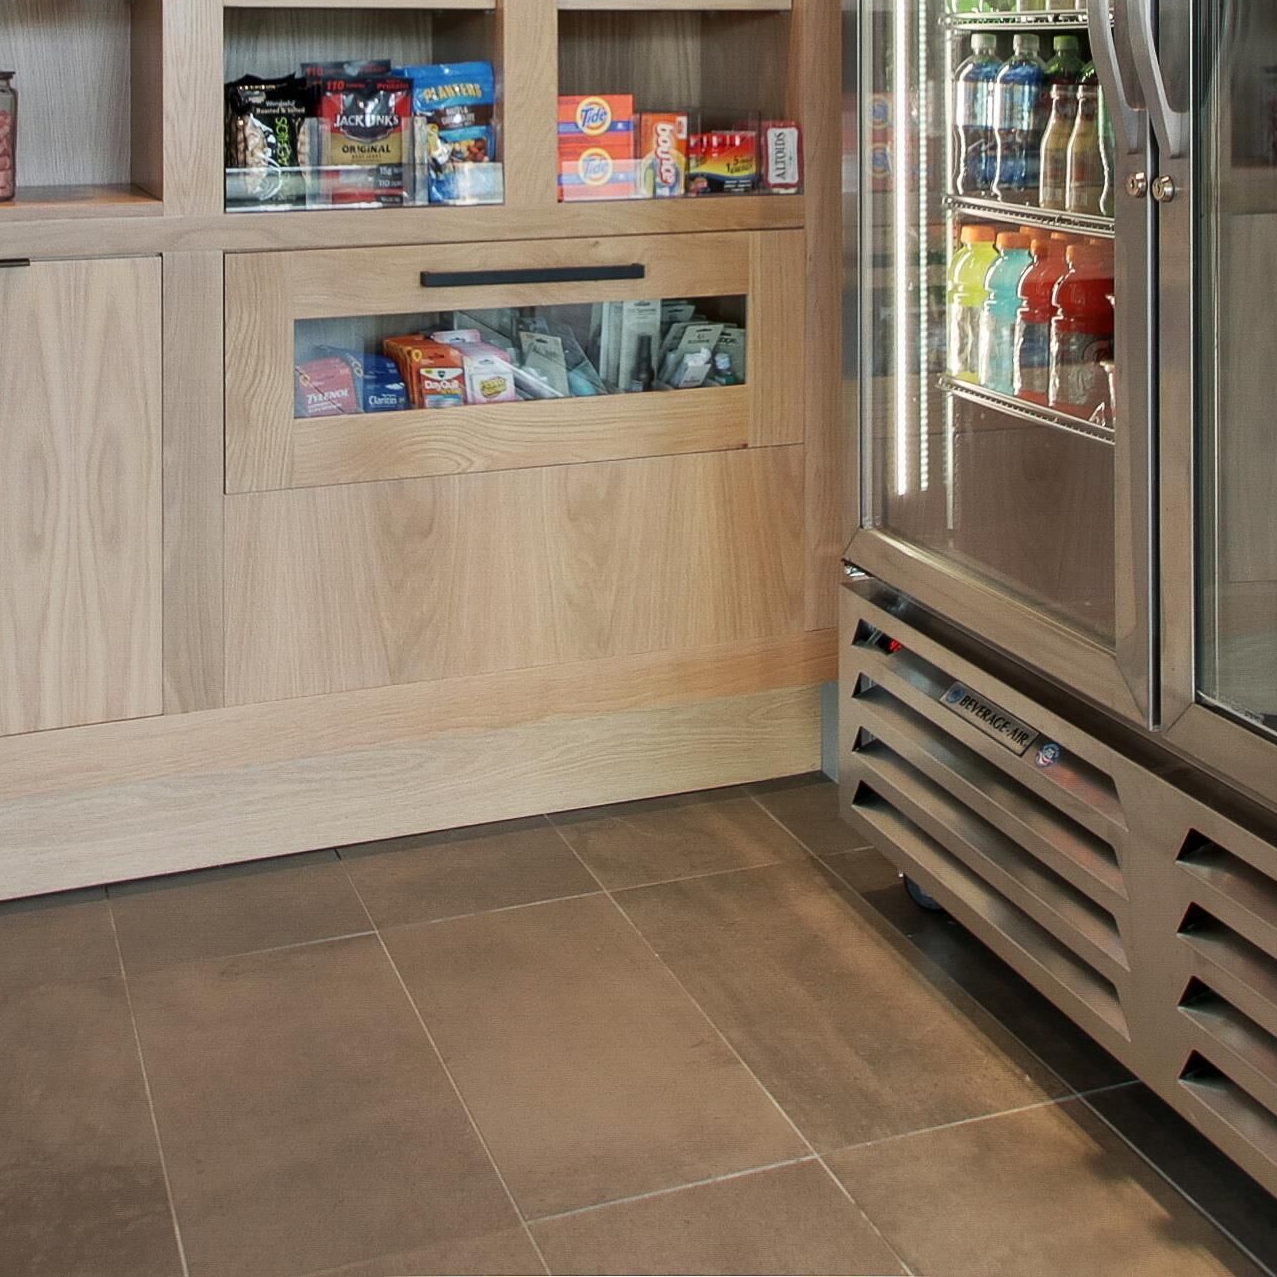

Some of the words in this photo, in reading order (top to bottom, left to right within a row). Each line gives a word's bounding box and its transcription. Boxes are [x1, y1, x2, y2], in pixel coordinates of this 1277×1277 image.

[424, 82, 483, 103] PLANTERS
[334, 115, 365, 128] JACK
[581, 106, 608, 126] Tide
[342, 144, 392, 154] ORIGINAL
[775, 131, 787, 180] ALTOIDS
[582, 158, 610, 177] Tide
[306, 388, 351, 405] TYLENOL
[368, 394, 398, 406] Claritin
[958, 694, 1030, 748] BEVERAGE-AIR
